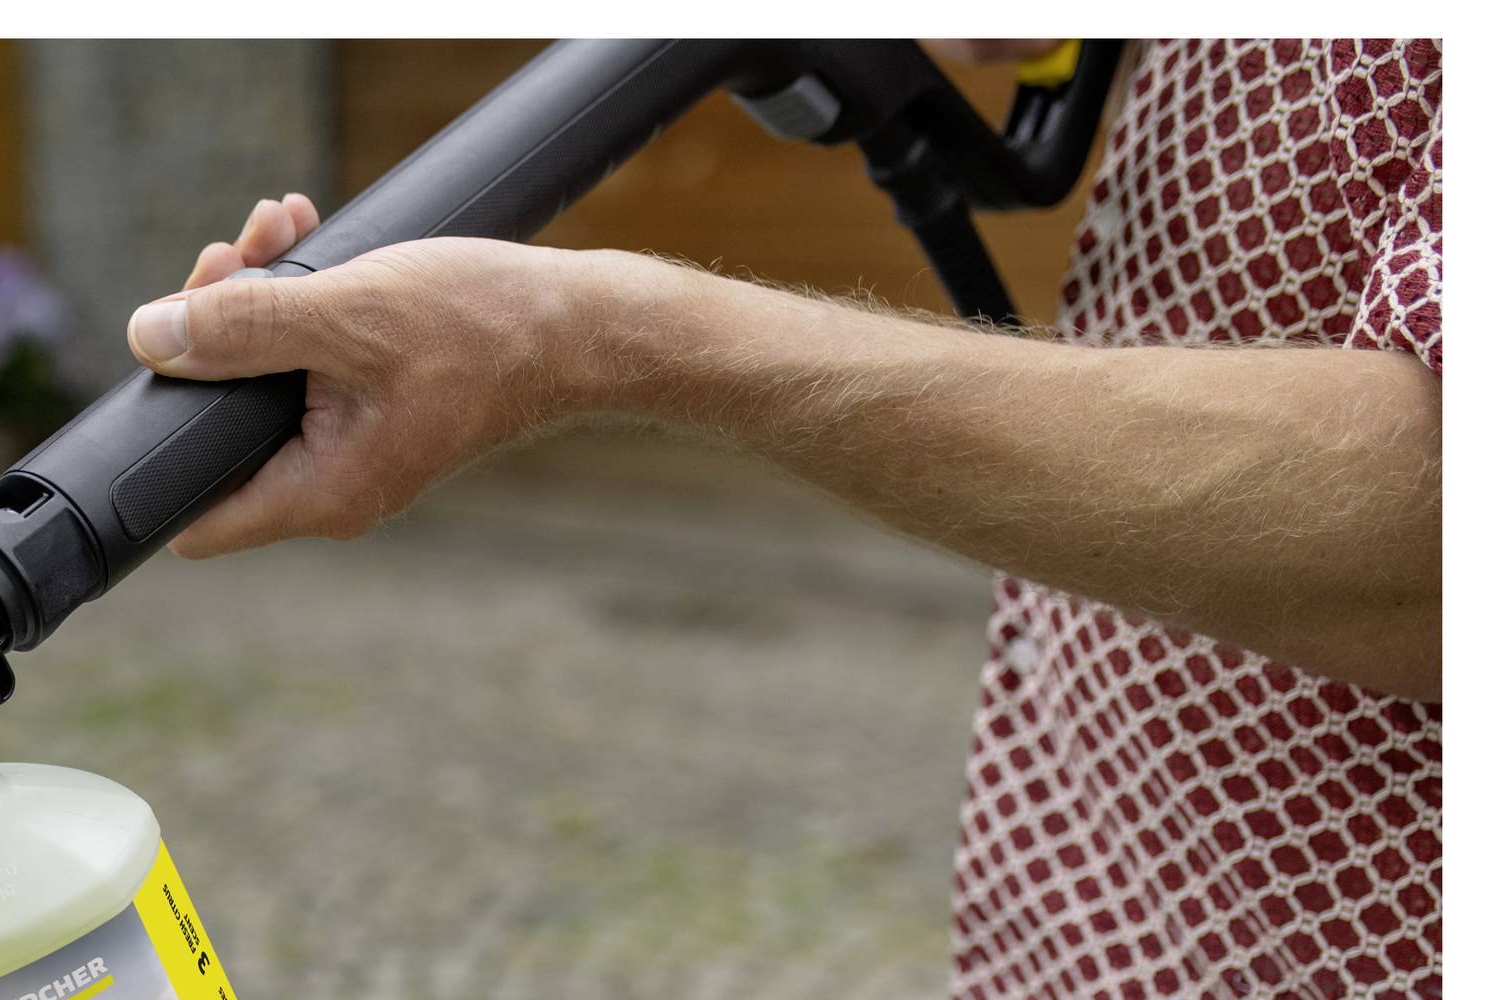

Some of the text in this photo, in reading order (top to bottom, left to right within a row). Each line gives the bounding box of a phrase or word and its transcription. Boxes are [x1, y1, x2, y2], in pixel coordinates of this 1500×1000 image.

[163, 883, 196, 954] FRESH CITRUS
[184, 914, 200, 946] SCENT
[198, 951, 210, 975] 3
